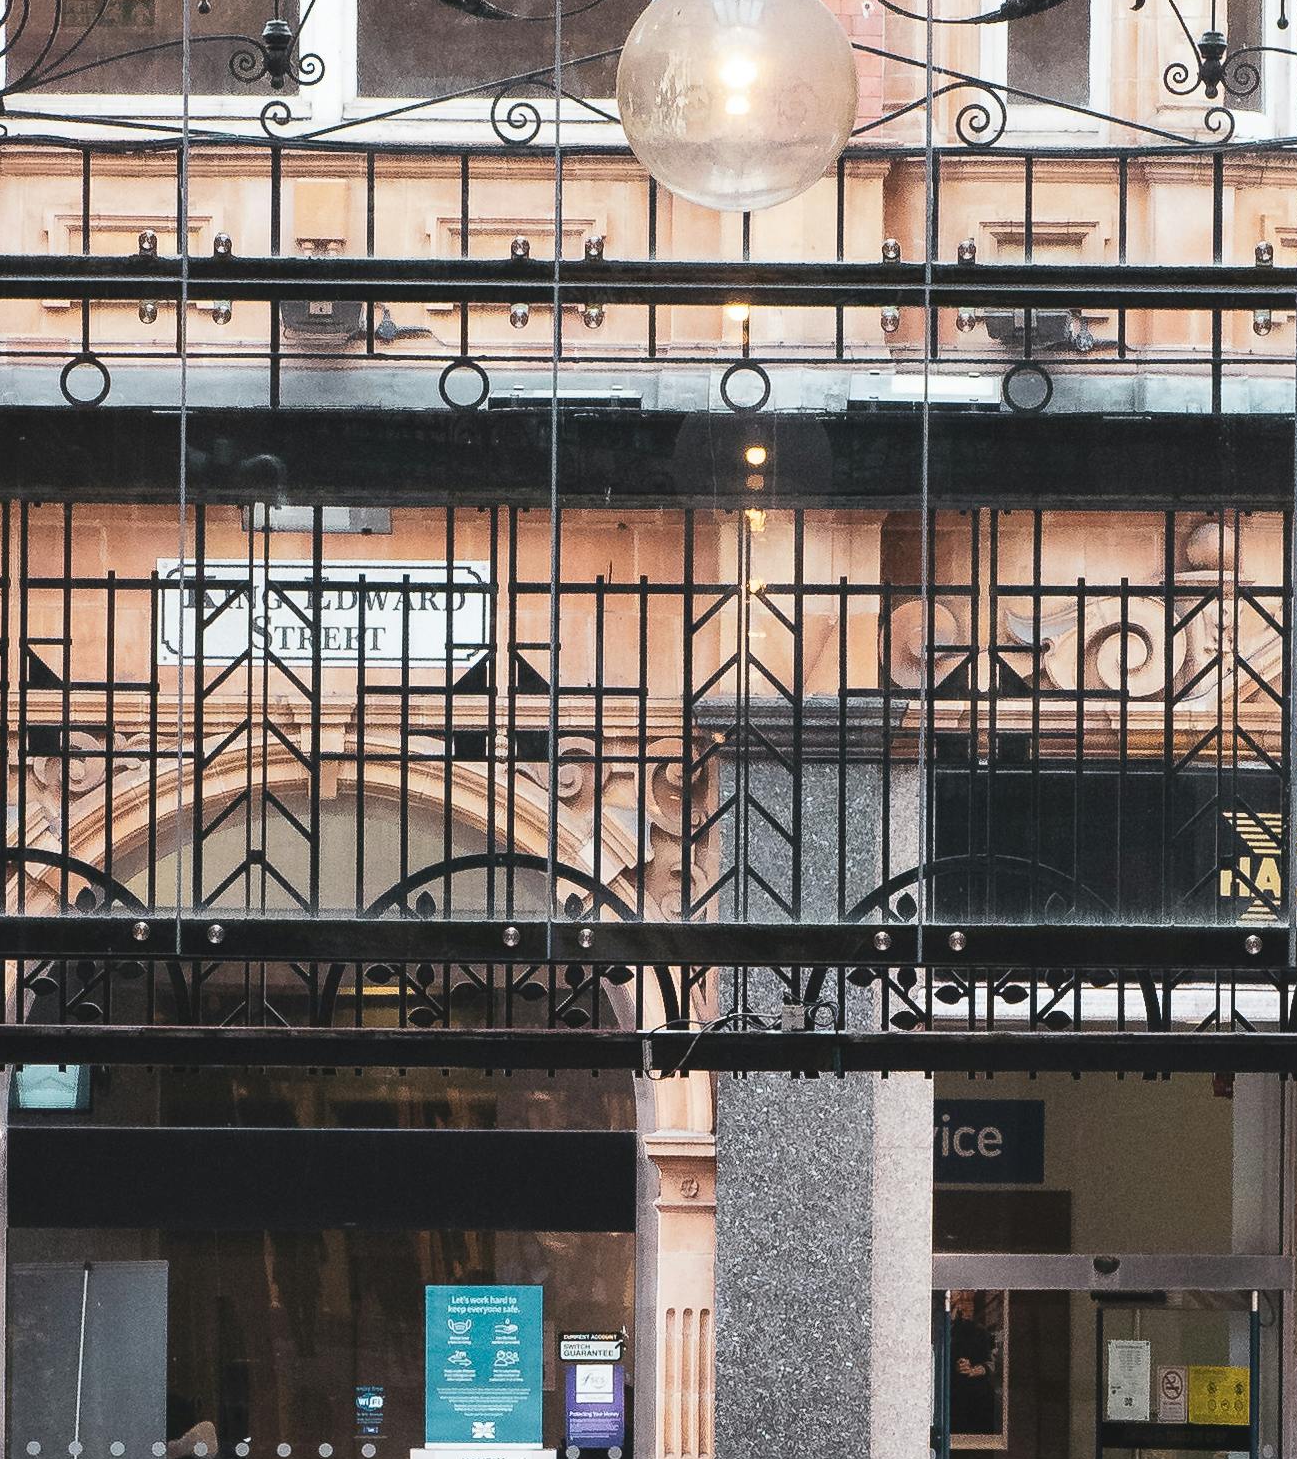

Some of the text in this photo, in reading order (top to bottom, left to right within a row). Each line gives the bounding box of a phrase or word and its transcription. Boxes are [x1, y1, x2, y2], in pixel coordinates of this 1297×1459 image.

[252, 615, 387, 651] STREET
[934, 1113, 1003, 1158] ice
[451, 1295, 517, 1304] Let's work hard to
[447, 1305, 467, 1314] keep
[467, 1306, 502, 1315] everyone
[563, 1349, 614, 1357] GUARANTEE
